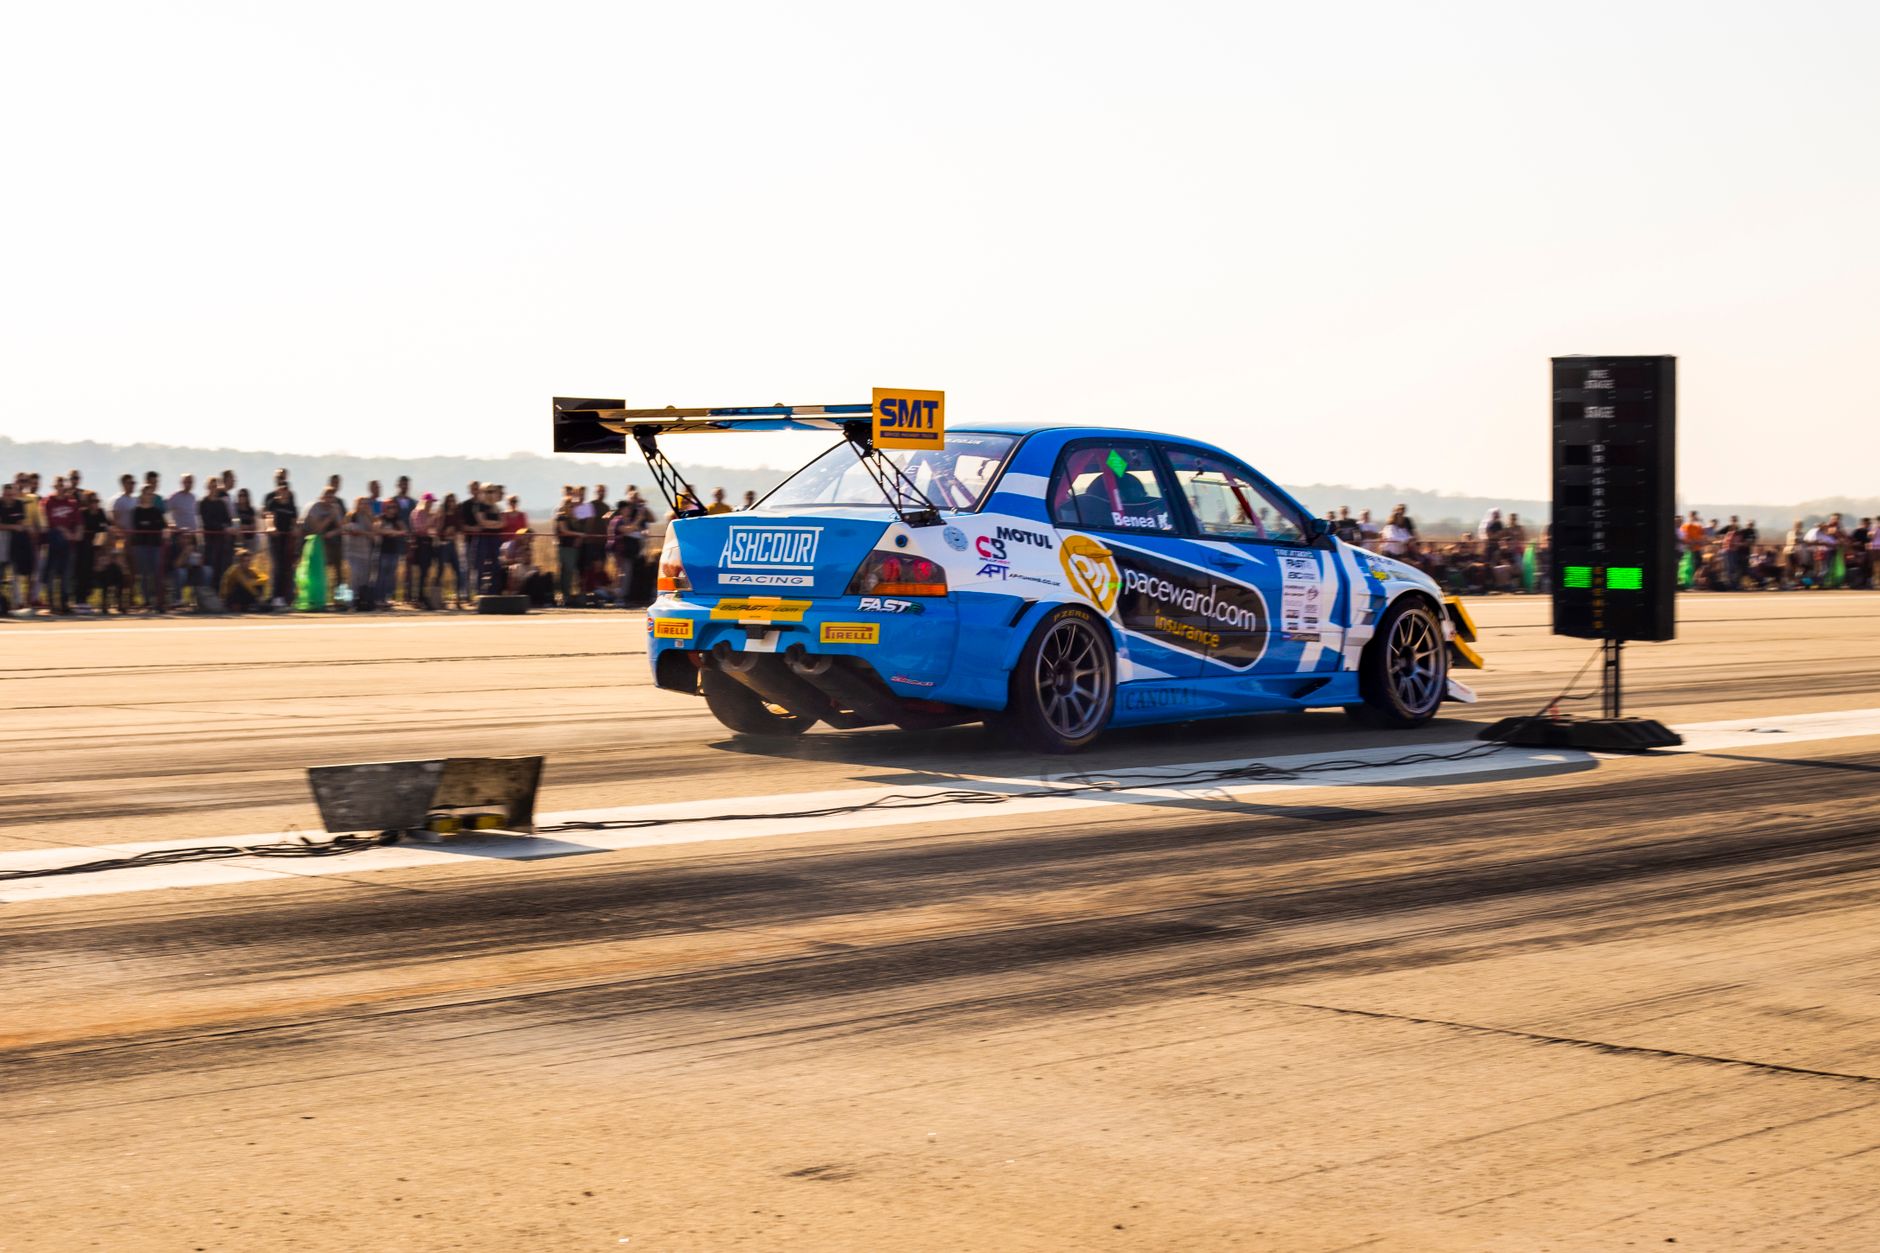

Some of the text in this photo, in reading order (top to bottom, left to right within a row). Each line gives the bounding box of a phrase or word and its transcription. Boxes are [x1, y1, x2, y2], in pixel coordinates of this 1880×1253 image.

[880, 398, 939, 428] SMT
[1111, 512, 1156, 528] Benea
[996, 526, 1053, 549] MOTUL
[729, 575, 804, 585] RACING
[976, 563, 1010, 580] APT
[1125, 568, 1256, 632] paceward.com
[657, 622, 689, 635] PIRELLI
[825, 626, 873, 640] PIRELLI
[1155, 609, 1220, 648] insurance
